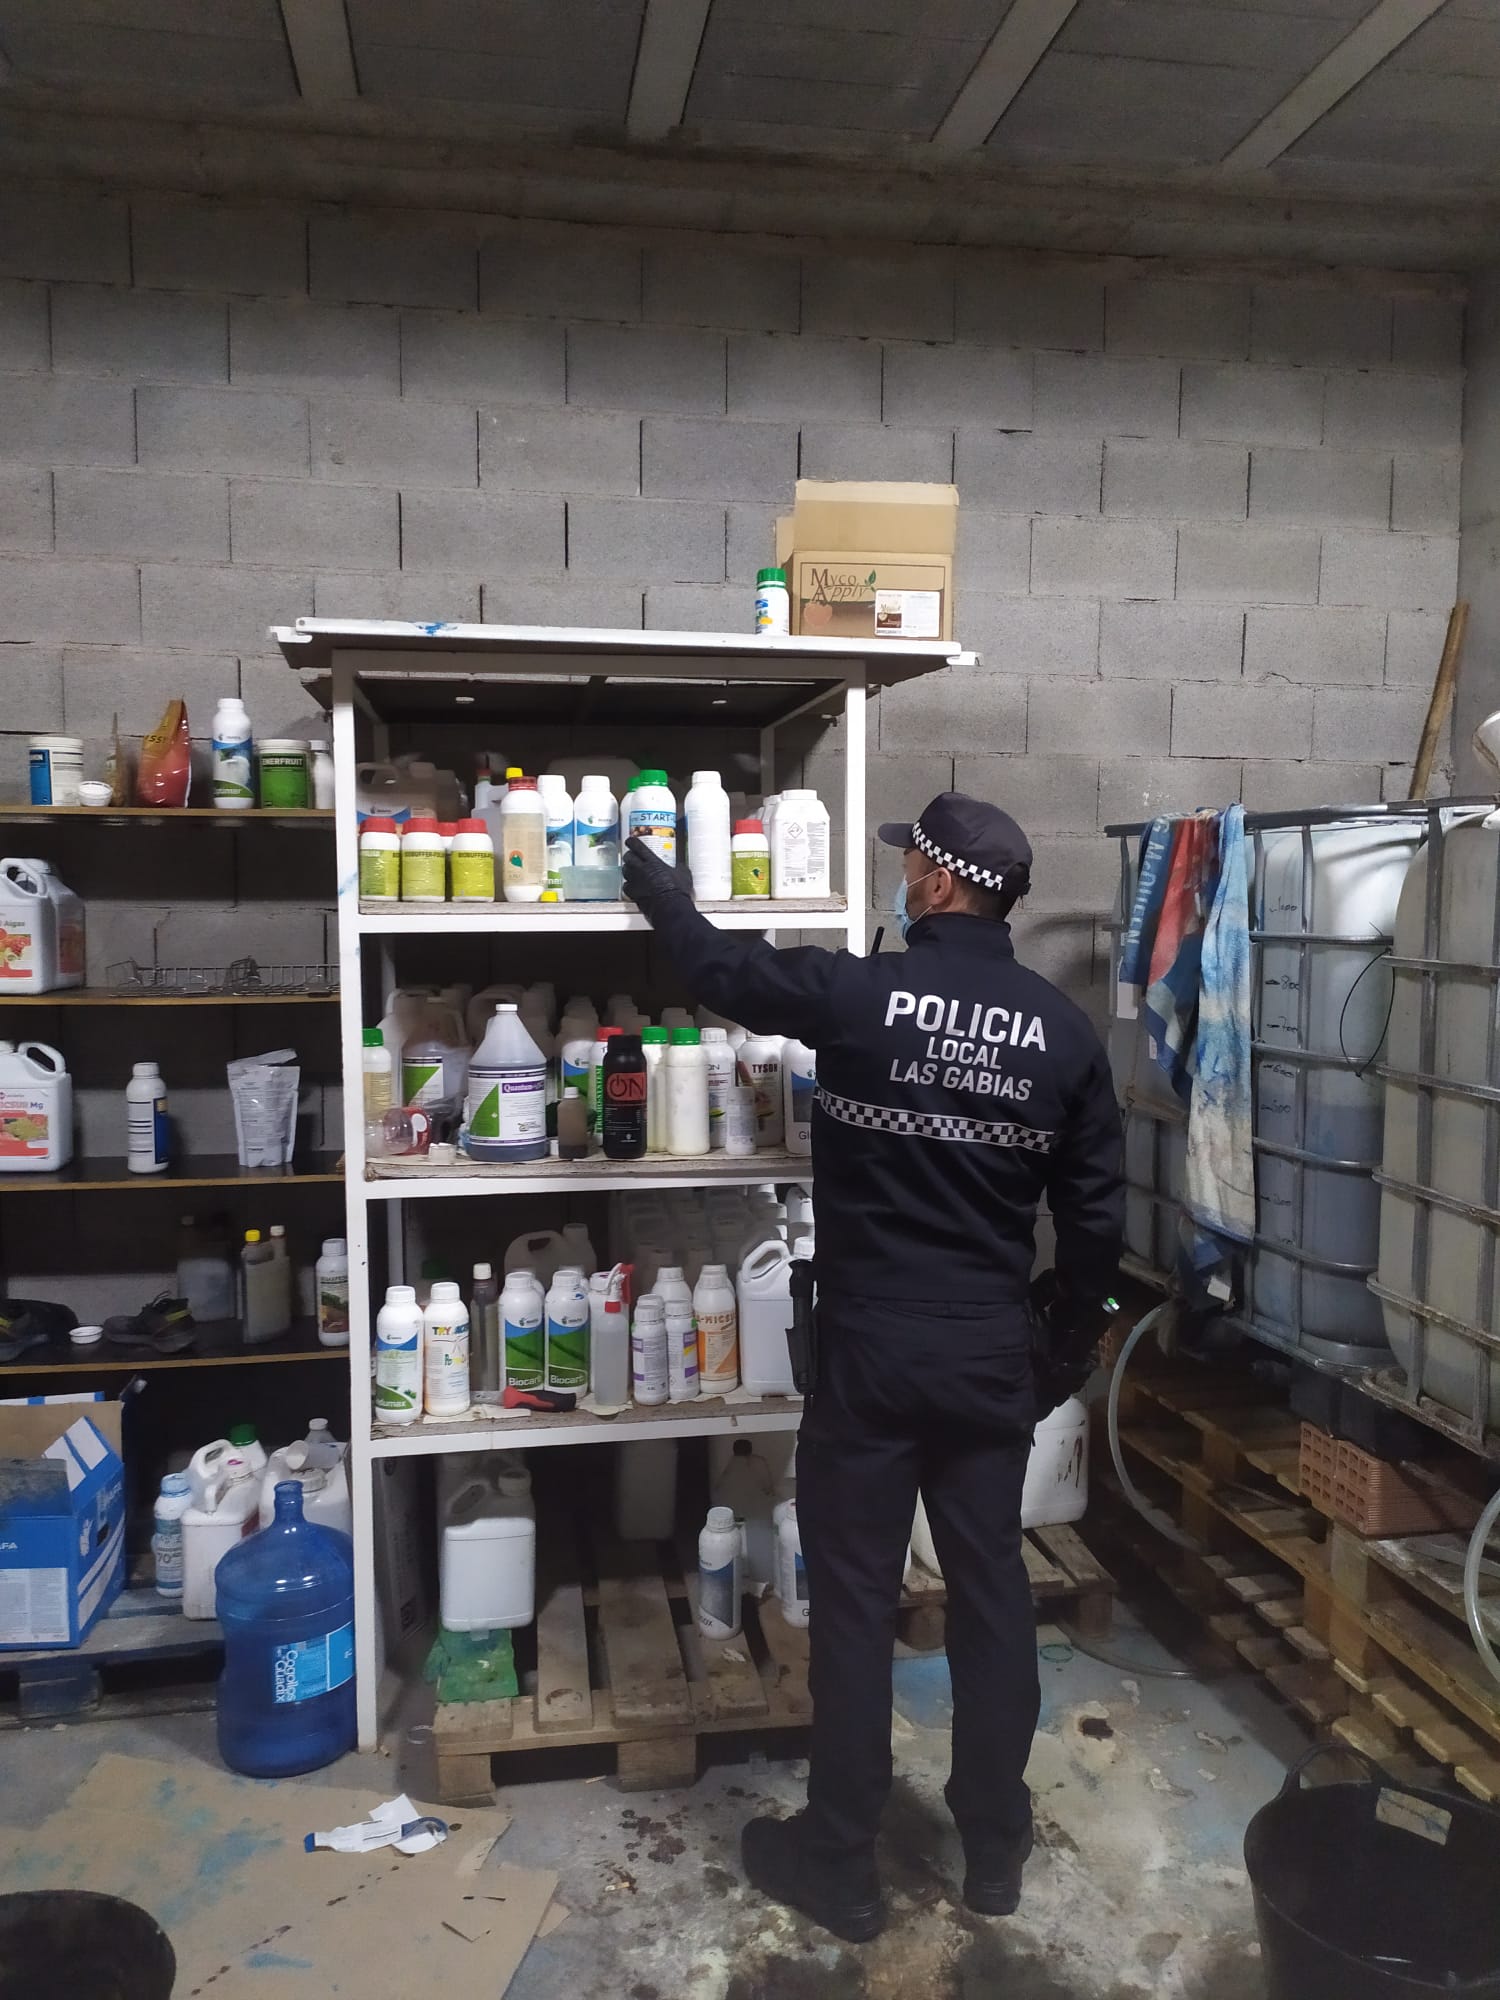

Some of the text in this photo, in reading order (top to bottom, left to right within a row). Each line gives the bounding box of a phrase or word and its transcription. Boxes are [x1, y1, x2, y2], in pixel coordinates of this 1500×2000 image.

[810, 568, 857, 587] Myco
[884, 991, 1047, 1052] POLICIA
[926, 1036, 1002, 1070] LOCAL
[889, 1058, 1033, 1101] LAS GABIAS
